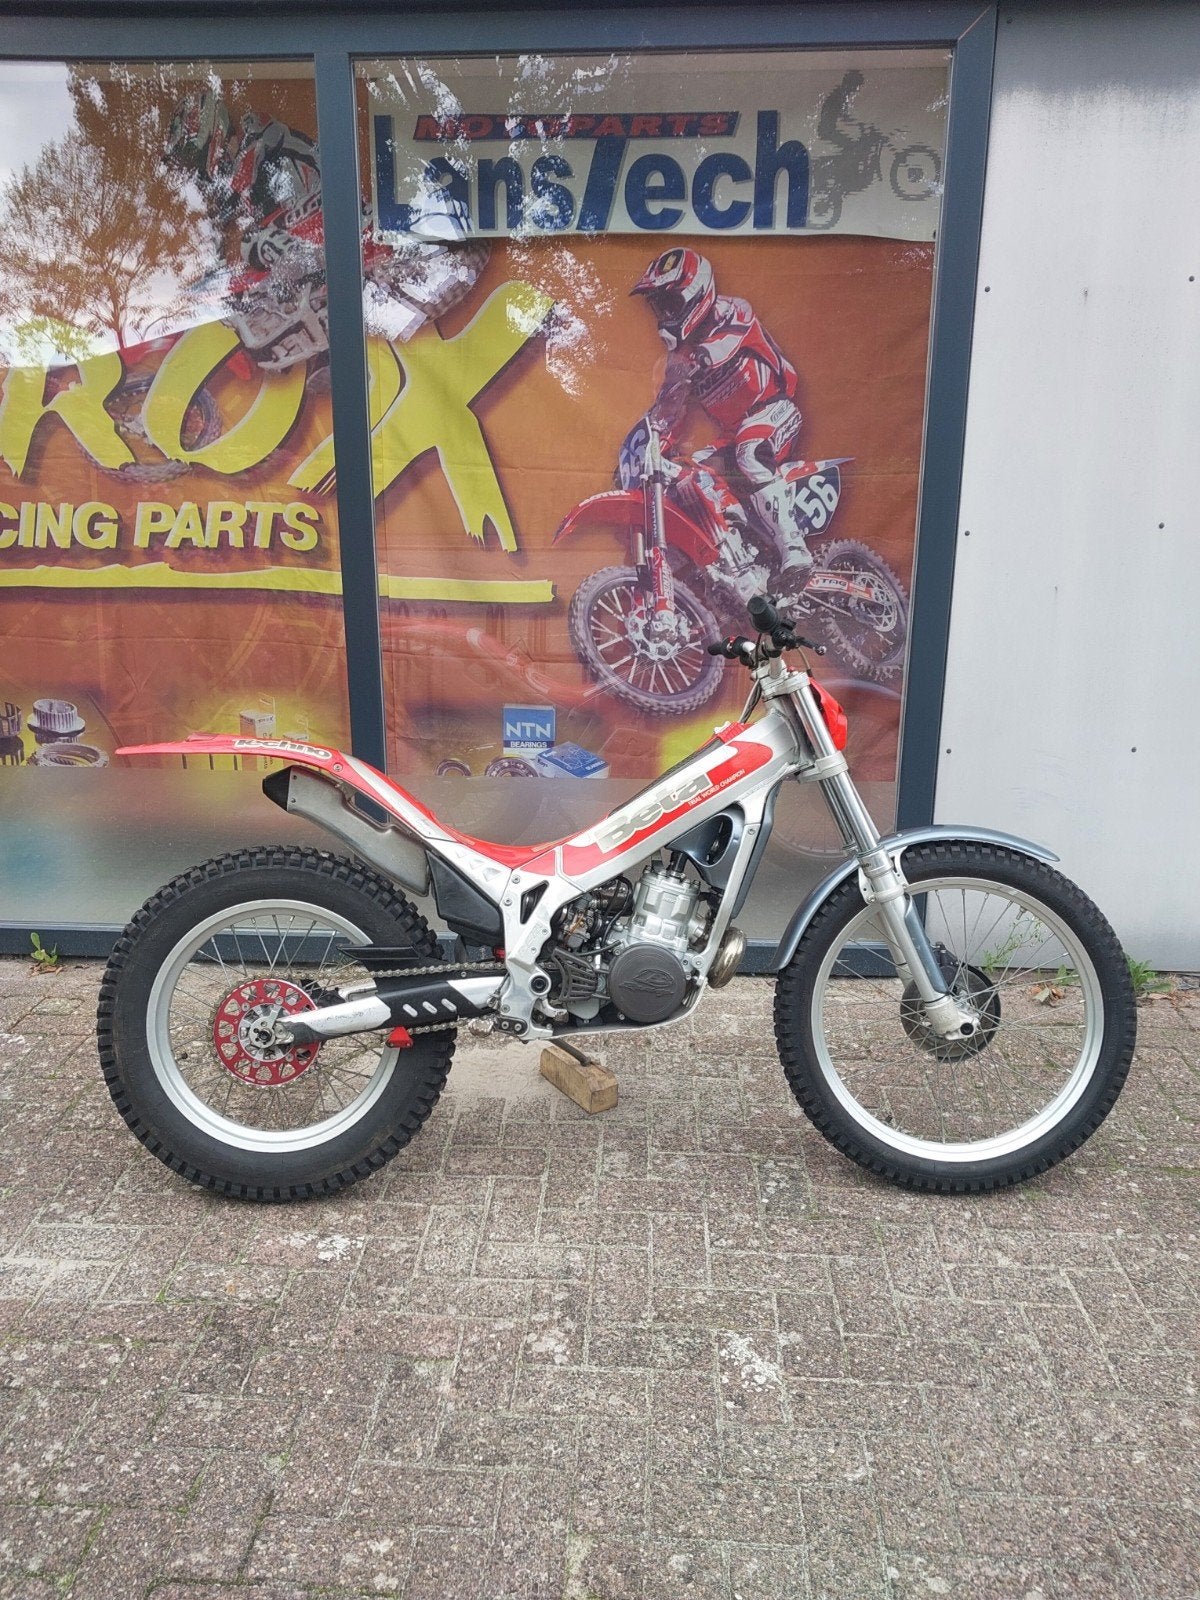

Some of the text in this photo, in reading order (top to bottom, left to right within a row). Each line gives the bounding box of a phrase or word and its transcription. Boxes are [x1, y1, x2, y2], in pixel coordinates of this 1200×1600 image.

[416, 114, 730, 139] MOOPARTS
[795, 474, 838, 529] 56
[133, 501, 319, 551] PARTS
[505, 721, 551, 738] NTN
[510, 740, 548, 748] BEARINGS
[701, 784, 720, 798] WORLD
[720, 769, 745, 787] CHAMPION
